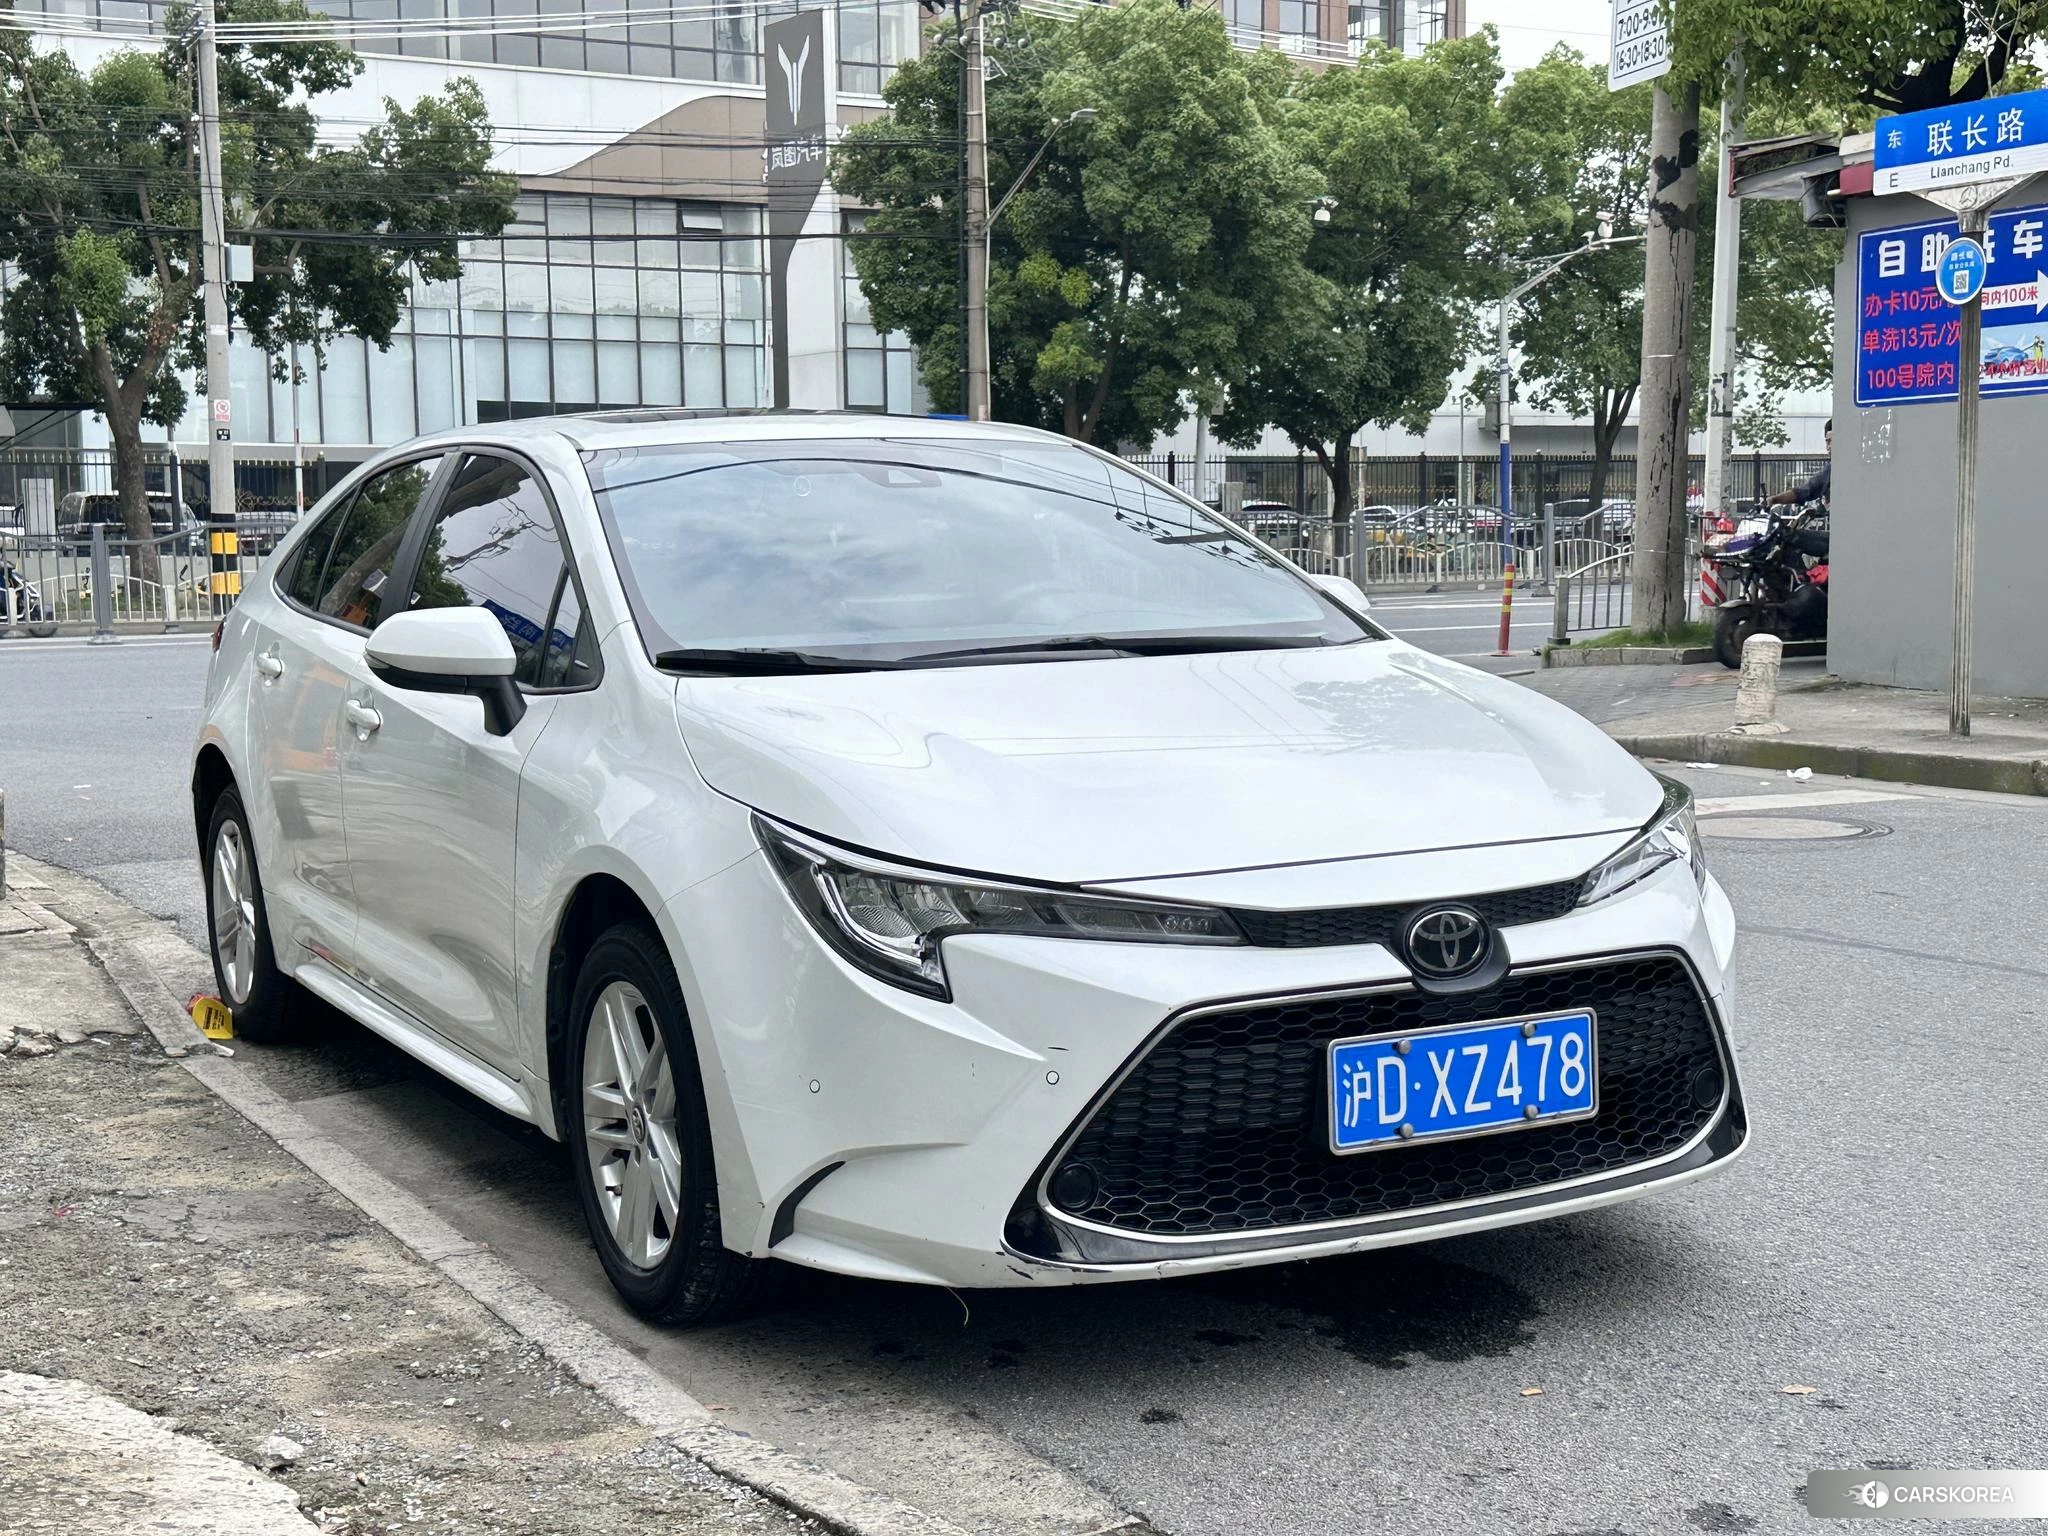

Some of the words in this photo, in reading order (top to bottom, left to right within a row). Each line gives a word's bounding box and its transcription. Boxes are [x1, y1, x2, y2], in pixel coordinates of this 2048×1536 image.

[1616, 35, 1664, 72] 16:30-18:30
[1887, 129, 1903, 149] 东
[1927, 107, 2025, 156] 联长路
[1889, 172, 1899, 188] E
[1930, 161, 1990, 179] Lianchang
[1993, 155, 2014, 170] Rd.
[1868, 361, 1954, 389] 100号院内
[1343, 1032, 1585, 1128] 沪D·XZ478
